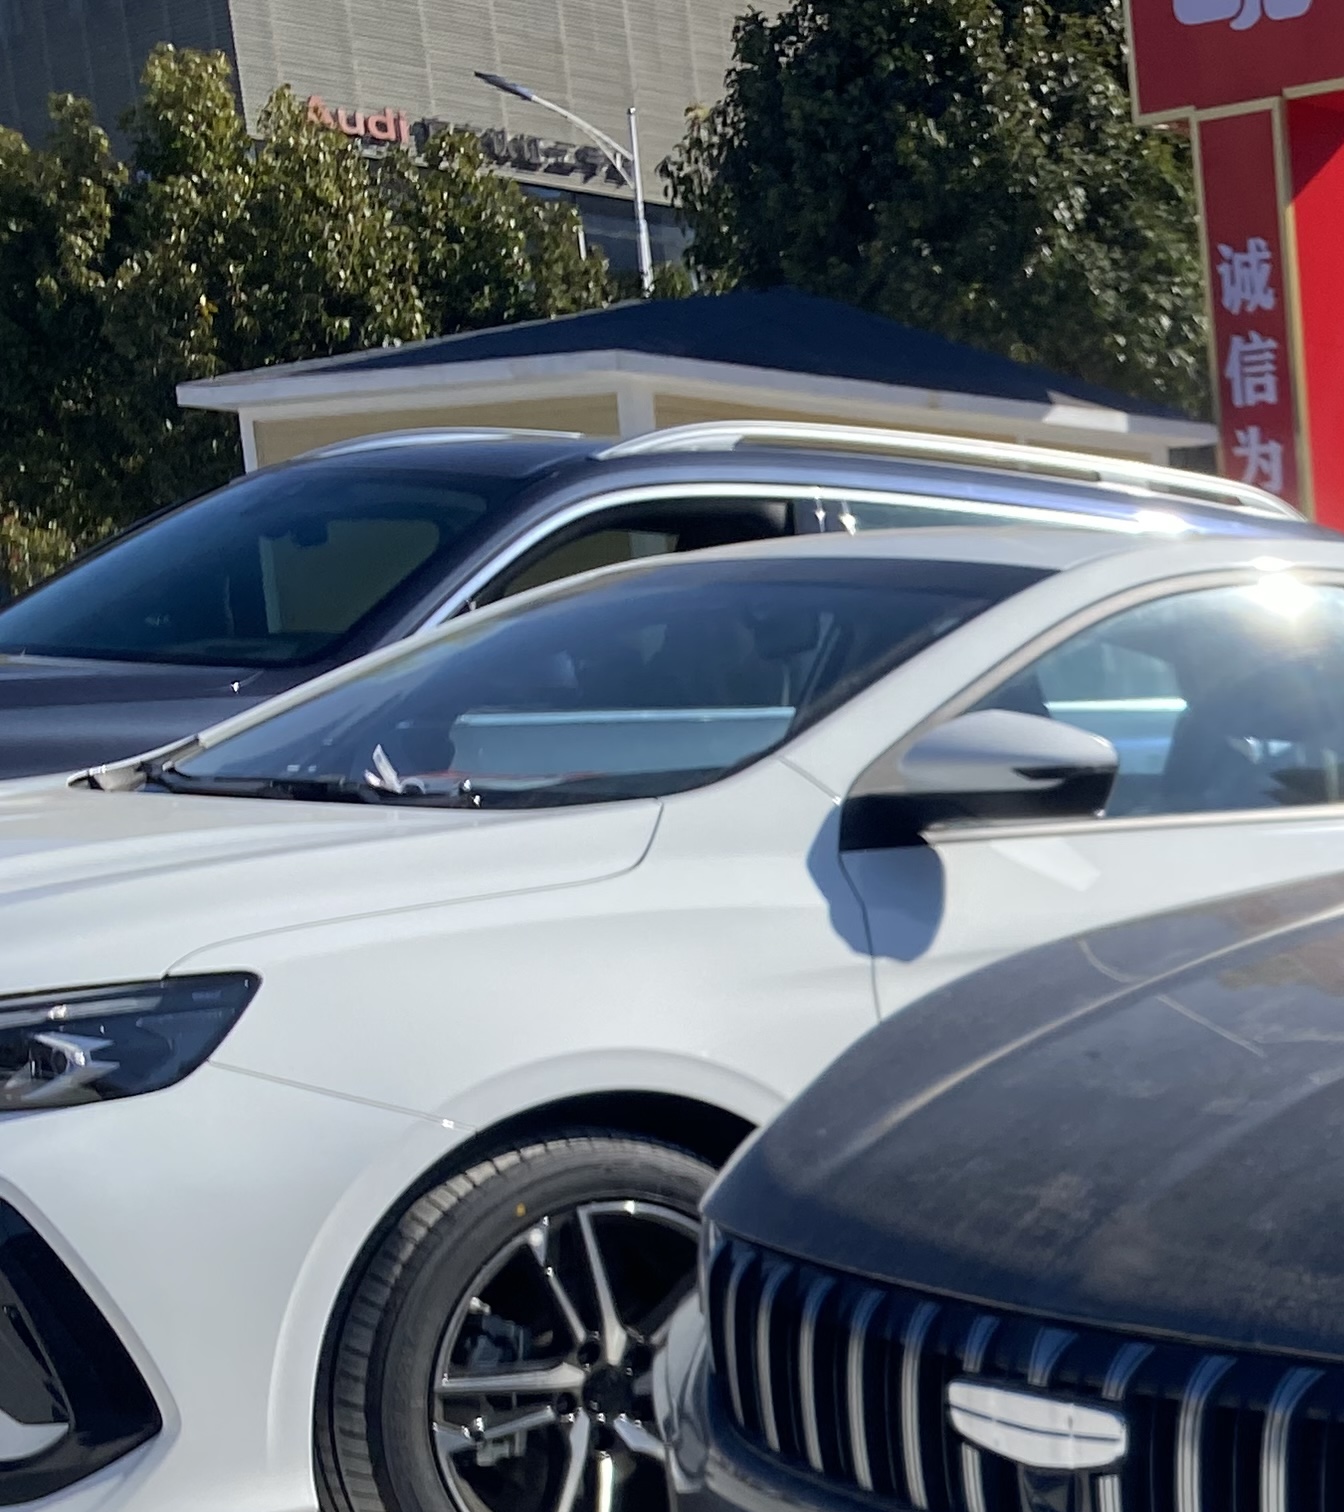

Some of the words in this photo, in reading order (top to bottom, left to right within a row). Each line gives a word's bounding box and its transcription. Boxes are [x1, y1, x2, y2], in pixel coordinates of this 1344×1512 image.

[307, 95, 410, 146] Audi
[1217, 236, 1284, 494] 诚信为
